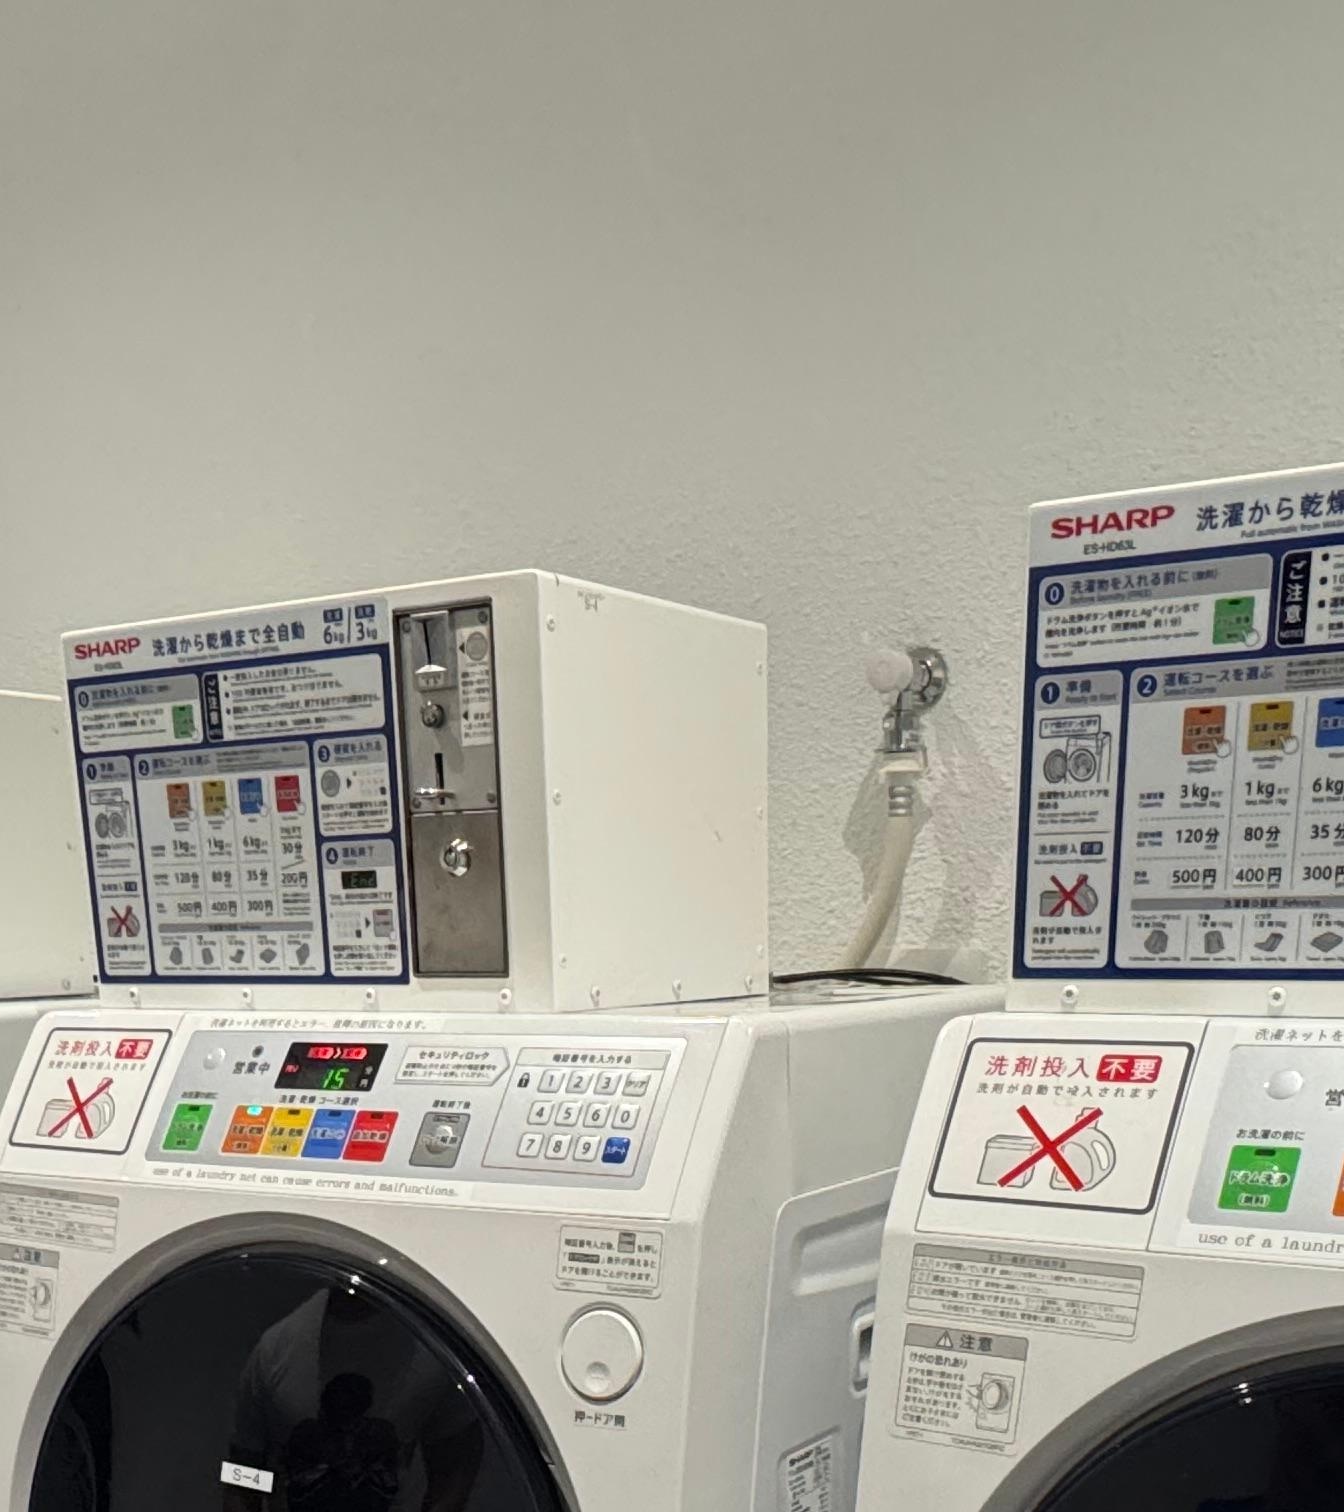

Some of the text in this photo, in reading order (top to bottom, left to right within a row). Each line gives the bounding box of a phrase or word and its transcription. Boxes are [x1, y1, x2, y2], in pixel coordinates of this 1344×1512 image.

[1050, 505, 1176, 540] SHARP
[74, 637, 141, 660] SHARP
[1176, 827, 1220, 844] 120分
[1244, 825, 1281, 842] 80分
[1172, 869, 1217, 885] 500円
[1235, 867, 1282, 883] 400円
[55, 1040, 149, 1059] 洗剤投入 不要
[985, 1055, 1158, 1081] 洗剤投入 不要
[573, 1075, 583, 1089] 2
[601, 1076, 611, 1089] 3
[976, 1082, 1159, 1099] 洗剤が自動で投入されます
[535, 1106, 544, 1119] 4
[563, 1107, 572, 1120] 5
[591, 1108, 600, 1122] 6
[620, 1110, 630, 1123] 0
[1236, 1128, 1305, 1141] お洗濯の前に
[526, 1138, 535, 1151] 7
[552, 1140, 562, 1153] 8
[581, 1141, 591, 1155] 9
[1198, 1232, 1228, 1246] use
[1234, 1233, 1254, 1248] of
[1261, 1238, 1272, 1249] a
[959, 1335, 993, 1352] 注意
